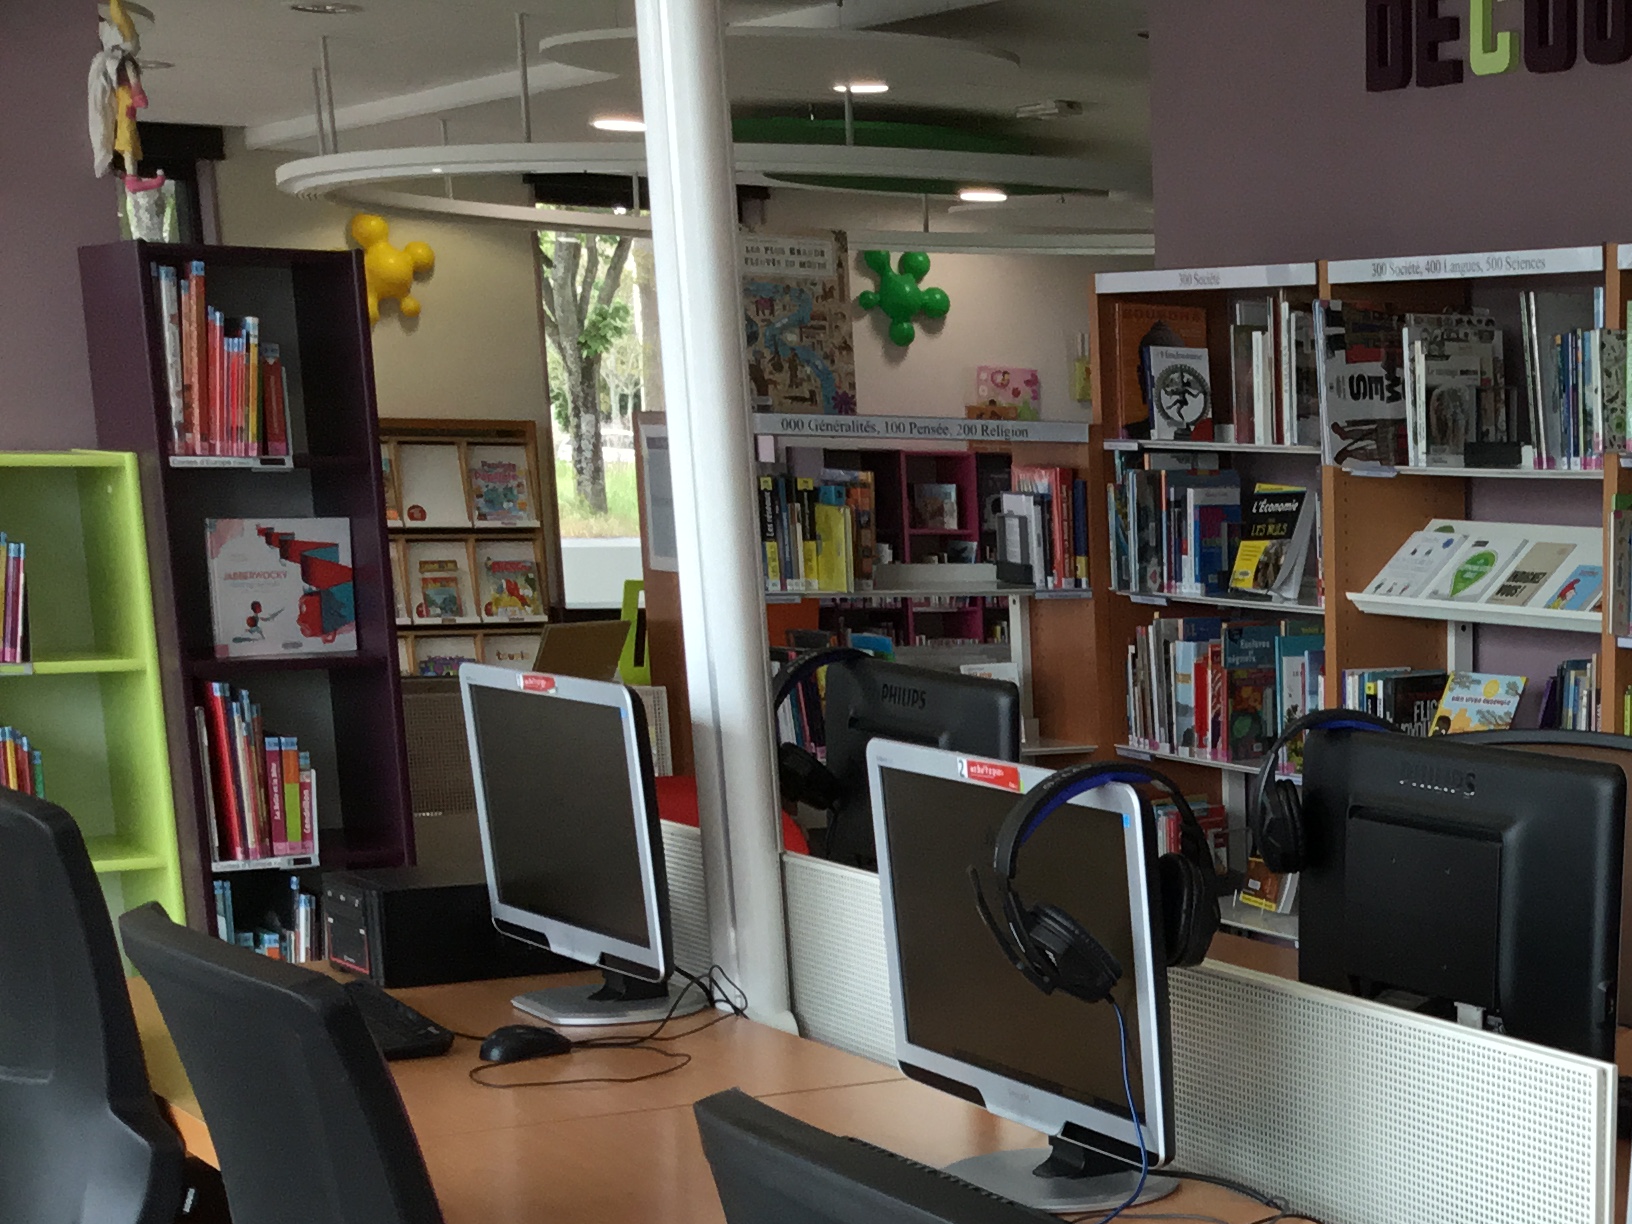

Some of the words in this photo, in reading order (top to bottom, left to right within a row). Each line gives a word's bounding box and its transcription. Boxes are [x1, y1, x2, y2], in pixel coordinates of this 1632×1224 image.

[1372, 263, 1387, 278] 300
[1425, 259, 1442, 274] 400
[1486, 257, 1503, 271] 500
[1505, 255, 1545, 271] Sciences
[781, 419, 804, 431] 000
[808, 419, 880, 435] Généralités,
[885, 422, 906, 434] 100
[957, 423, 977, 436] 200
[981, 423, 1028, 440] Religion
[881, 683, 927, 710] PHILIPS
